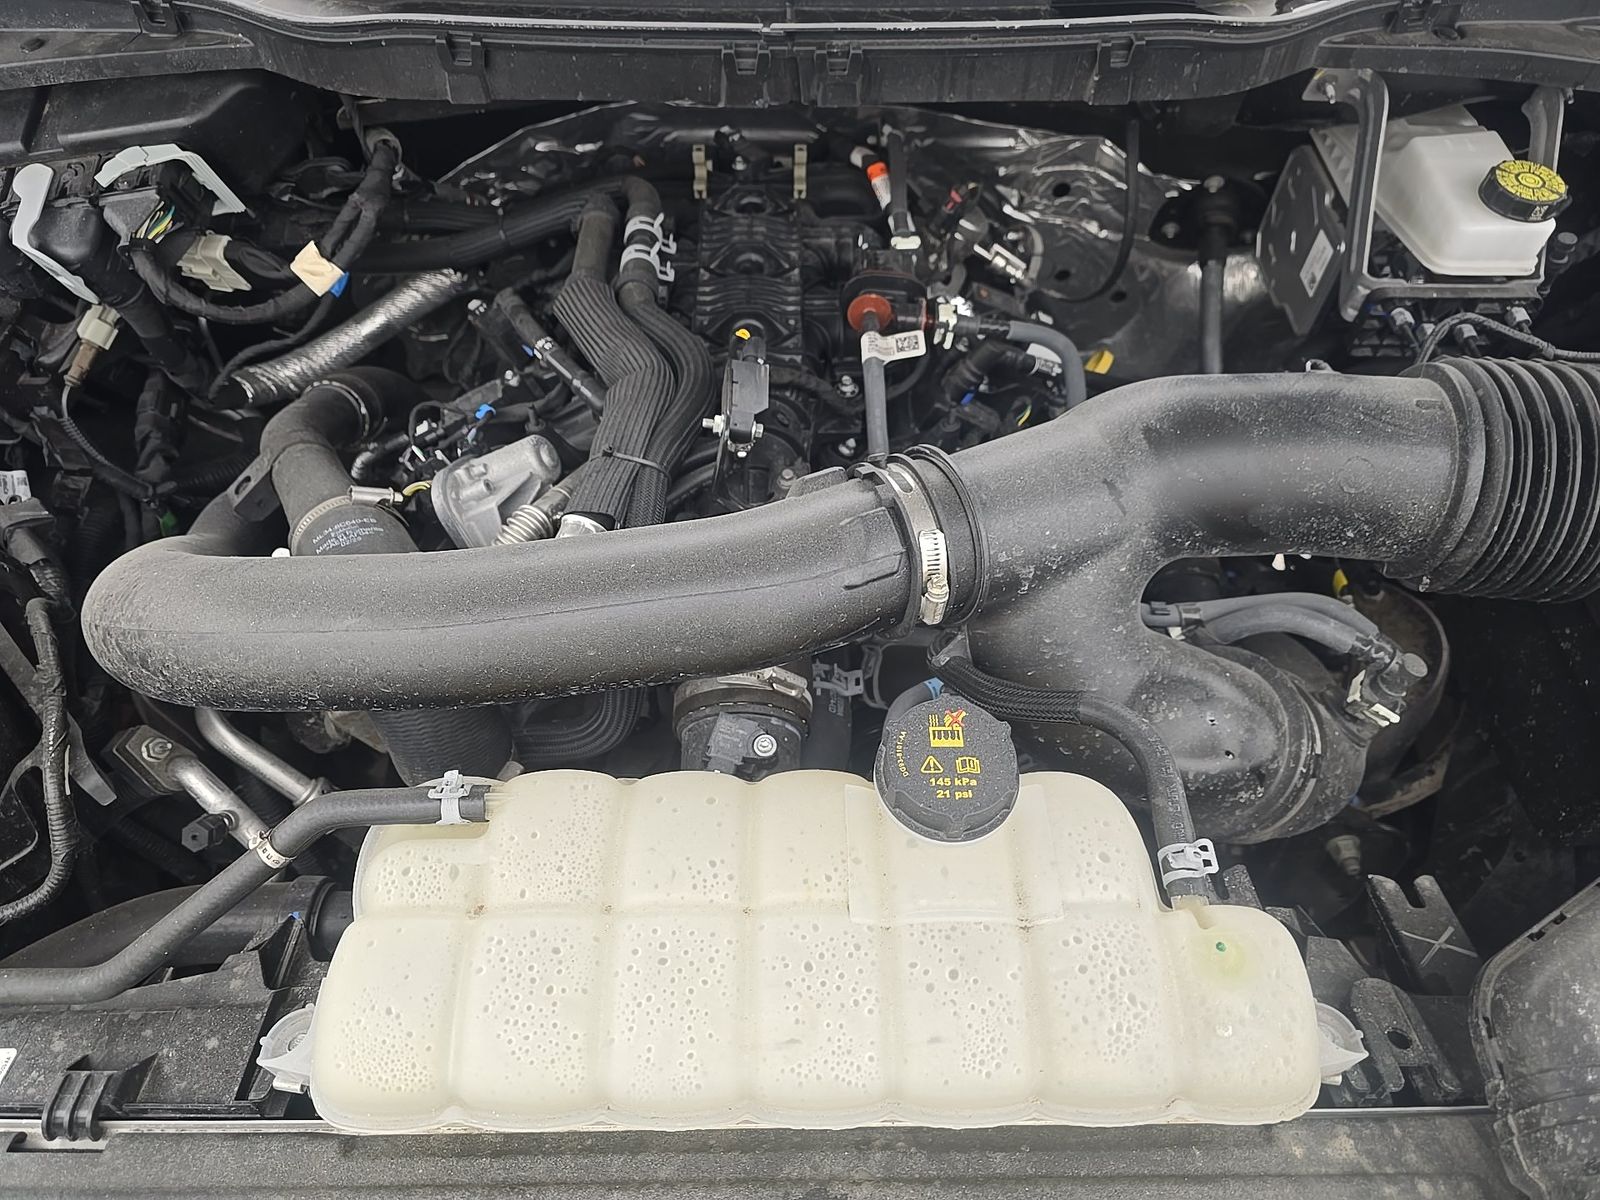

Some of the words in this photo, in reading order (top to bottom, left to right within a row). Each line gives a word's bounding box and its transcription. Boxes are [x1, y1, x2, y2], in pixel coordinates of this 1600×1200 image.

[930, 778, 951, 786] 145
[955, 778, 977, 786] kPa
[936, 790, 950, 798] 21
[955, 790, 973, 800] psi
